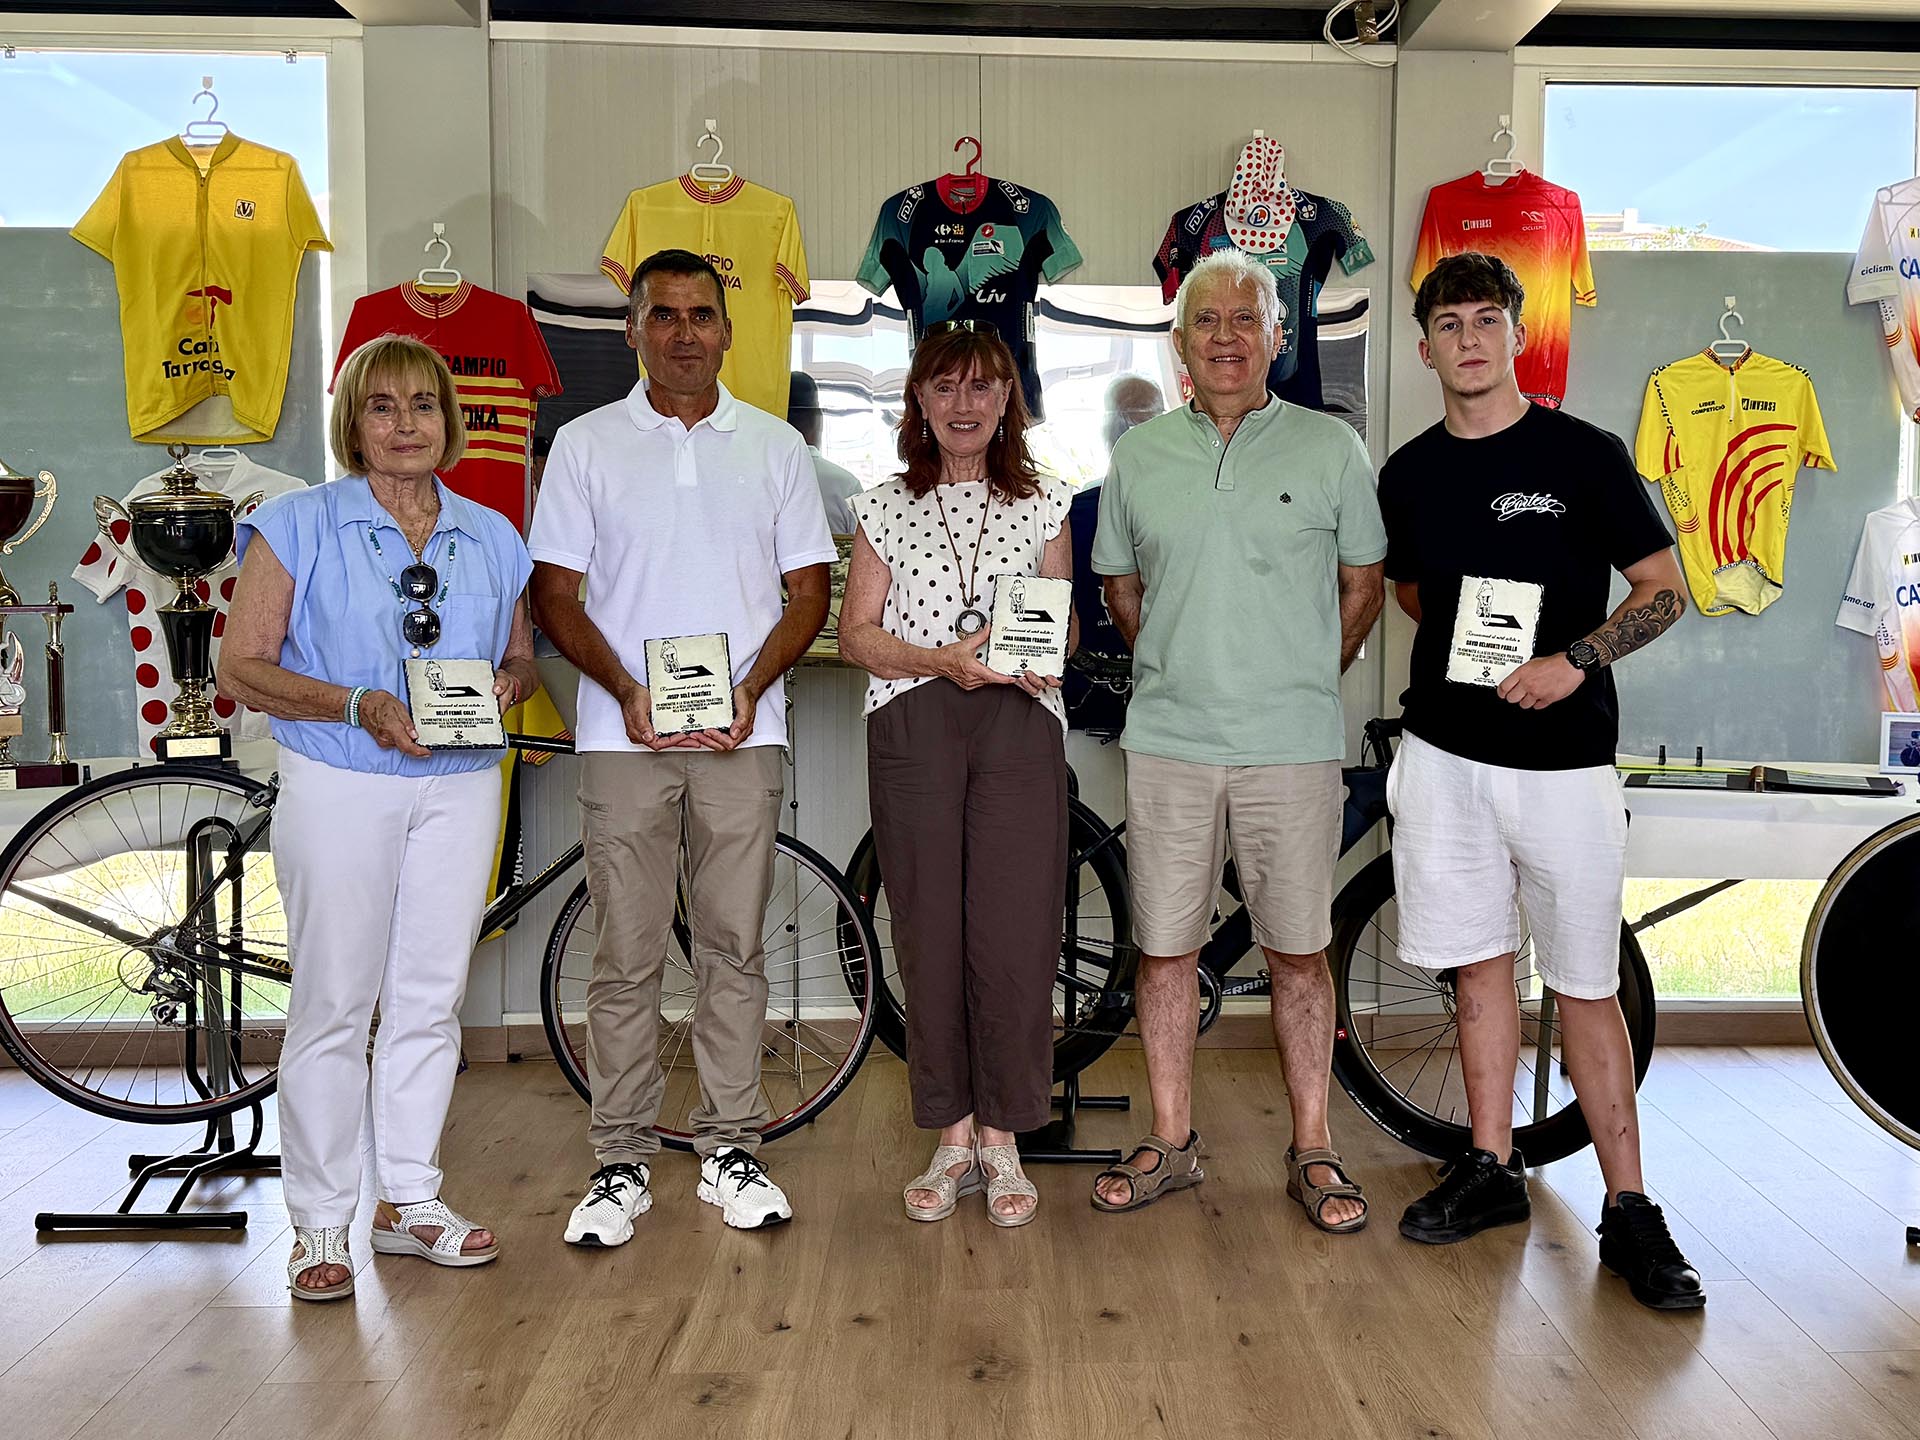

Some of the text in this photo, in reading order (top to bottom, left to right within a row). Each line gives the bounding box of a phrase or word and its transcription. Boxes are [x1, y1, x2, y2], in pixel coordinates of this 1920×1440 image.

[1001, 181, 1018, 198] FDJ
[901, 200, 914, 220] FDJ
[1188, 209, 1204, 232] FDJ
[976, 289, 1007, 303] Liv
